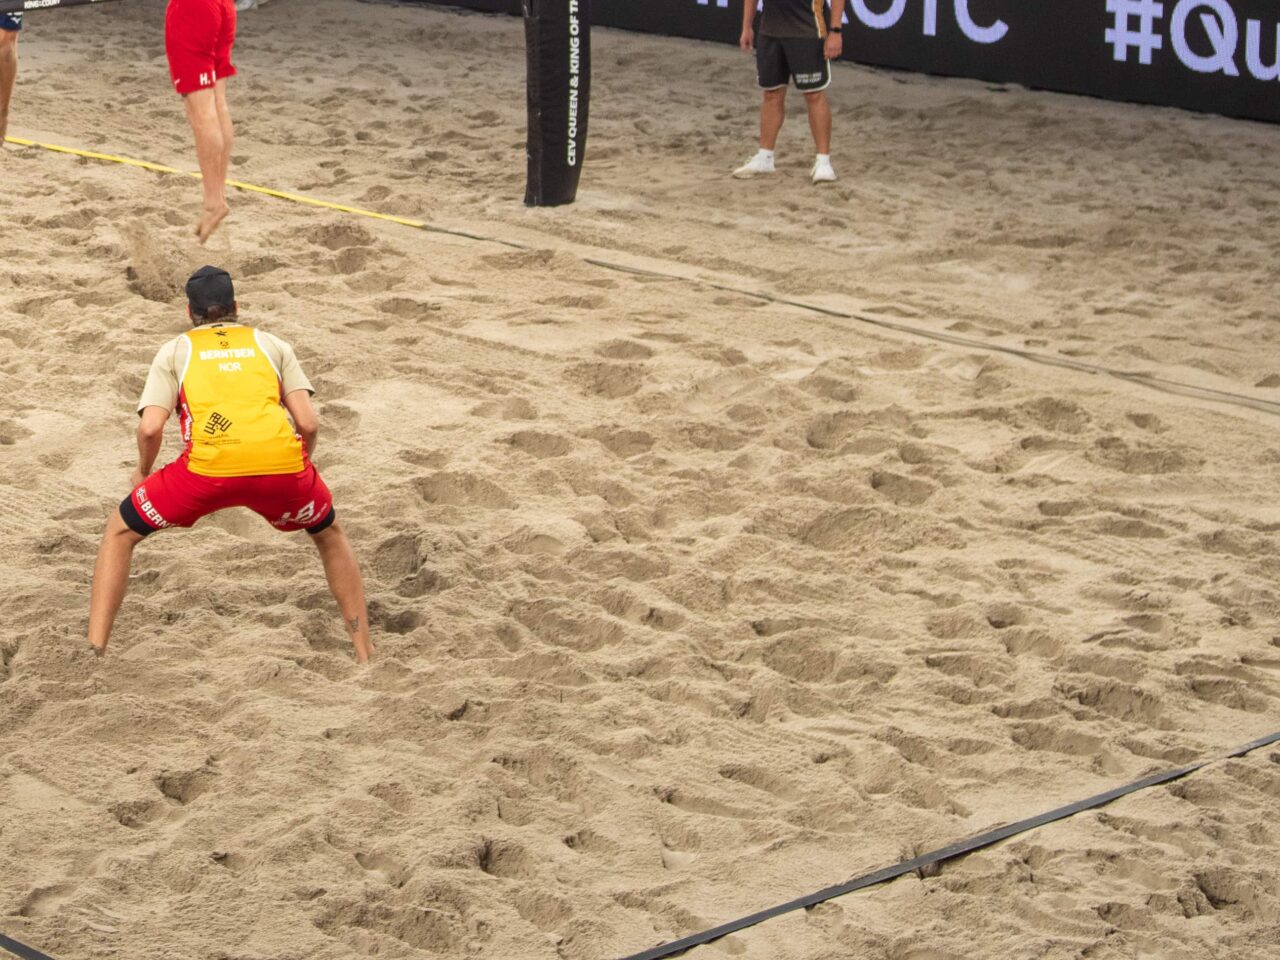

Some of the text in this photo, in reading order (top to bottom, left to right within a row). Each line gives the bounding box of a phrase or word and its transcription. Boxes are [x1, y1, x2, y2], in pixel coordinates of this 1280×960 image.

[569, 16, 579, 34] OF
[570, 39, 579, 74] KING
[570, 76, 579, 88] &
[568, 89, 578, 136] QUEEN
[567, 140, 577, 166] CEV
[199, 347, 255, 361] BERNTSEN
[218, 362, 242, 372] NOR
